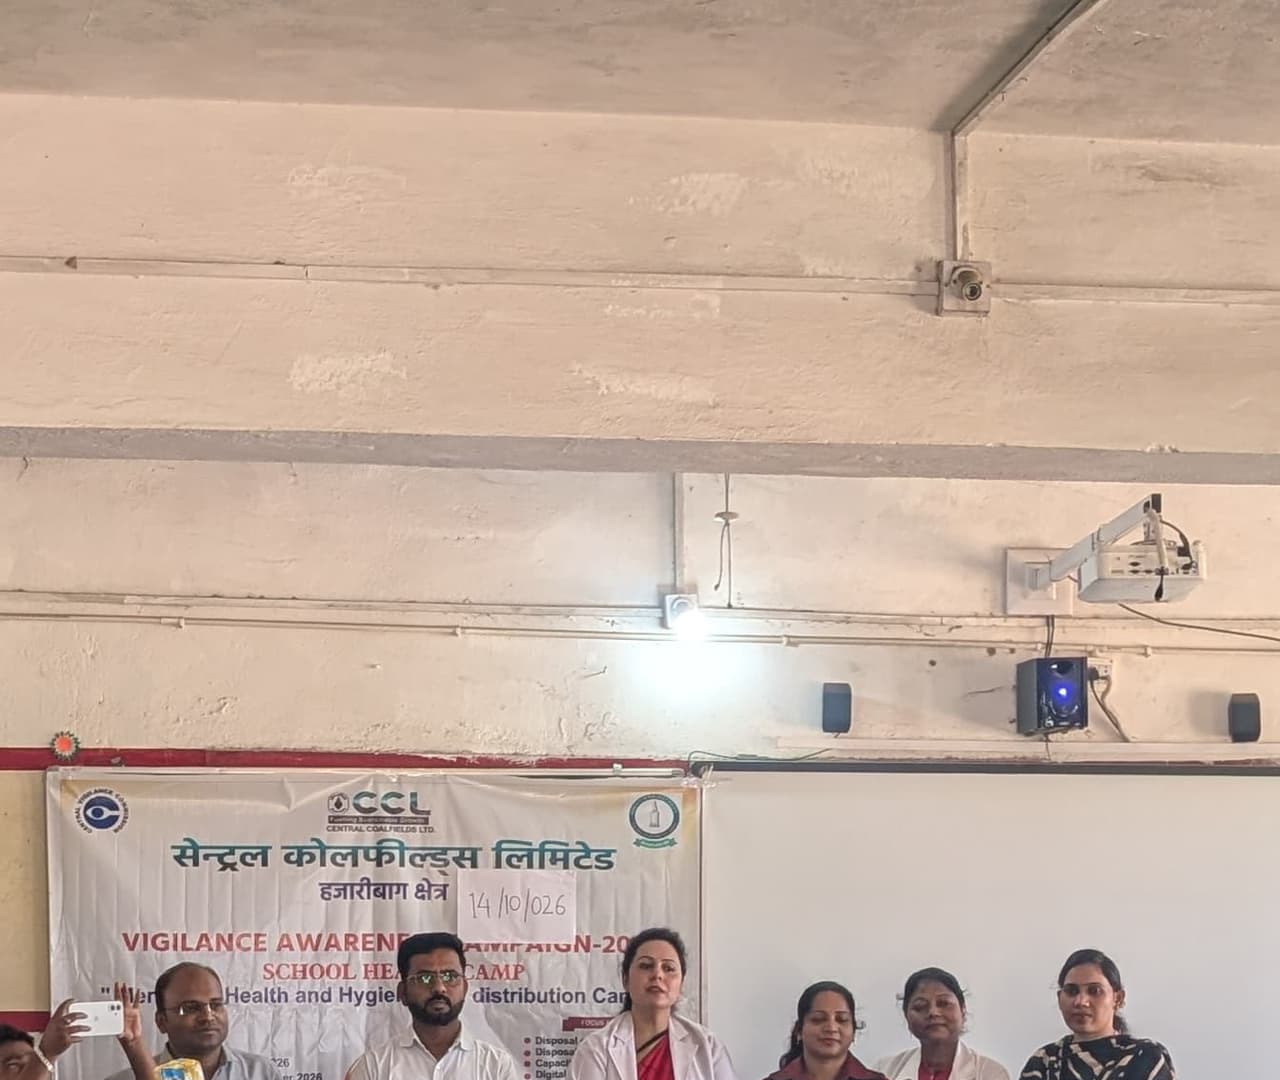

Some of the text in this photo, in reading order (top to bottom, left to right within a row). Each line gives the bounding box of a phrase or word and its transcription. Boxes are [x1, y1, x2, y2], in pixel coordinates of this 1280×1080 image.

[352, 791, 431, 815] CCL
[326, 825, 365, 833] CENTRAL
[366, 826, 418, 834] COALFIELDS
[171, 837, 272, 871] सेन्ट्रल
[491, 840, 617, 870] लिमिटेड
[318, 877, 449, 900] हजारीबाग क्षेत्र
[122, 932, 267, 952] VIGILANCE
[263, 963, 357, 981] SCHOOL
[225, 987, 289, 1004] Health
[297, 987, 332, 1004] and
[339, 987, 401, 1007] Hygie
[473, 988, 586, 1005] distribution
[535, 1036, 578, 1046] Disposal
[535, 1047, 576, 1057] Disposa
[535, 1070, 567, 1080] Digital
